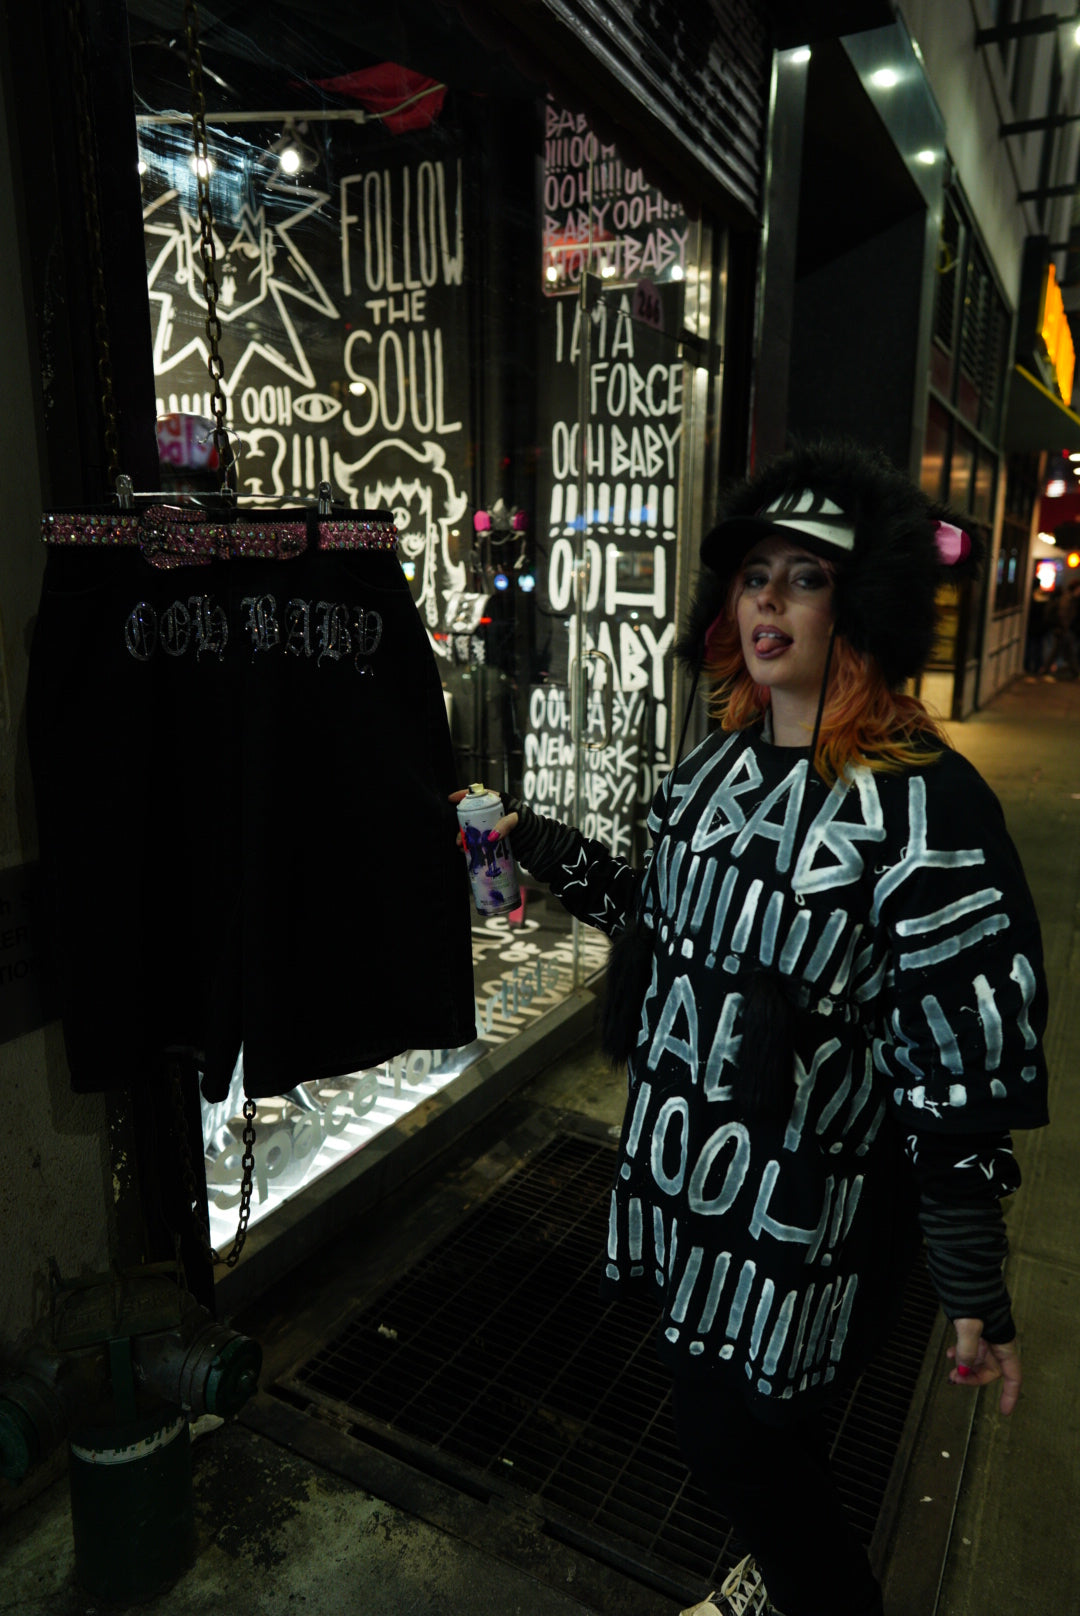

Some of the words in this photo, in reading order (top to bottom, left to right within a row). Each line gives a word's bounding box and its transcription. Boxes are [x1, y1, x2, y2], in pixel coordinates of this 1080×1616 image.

[340, 159, 463, 296] FOLLOW
[624, 227, 690, 279] BABY
[365, 290, 426, 325] THE
[343, 327, 462, 436] SOUL
[590, 362, 684, 417] FORCE
[611, 423, 684, 480] BABY
[549, 538, 668, 619] OOH
[524, 732, 576, 768] NEW
[523, 767, 562, 806] OOH
